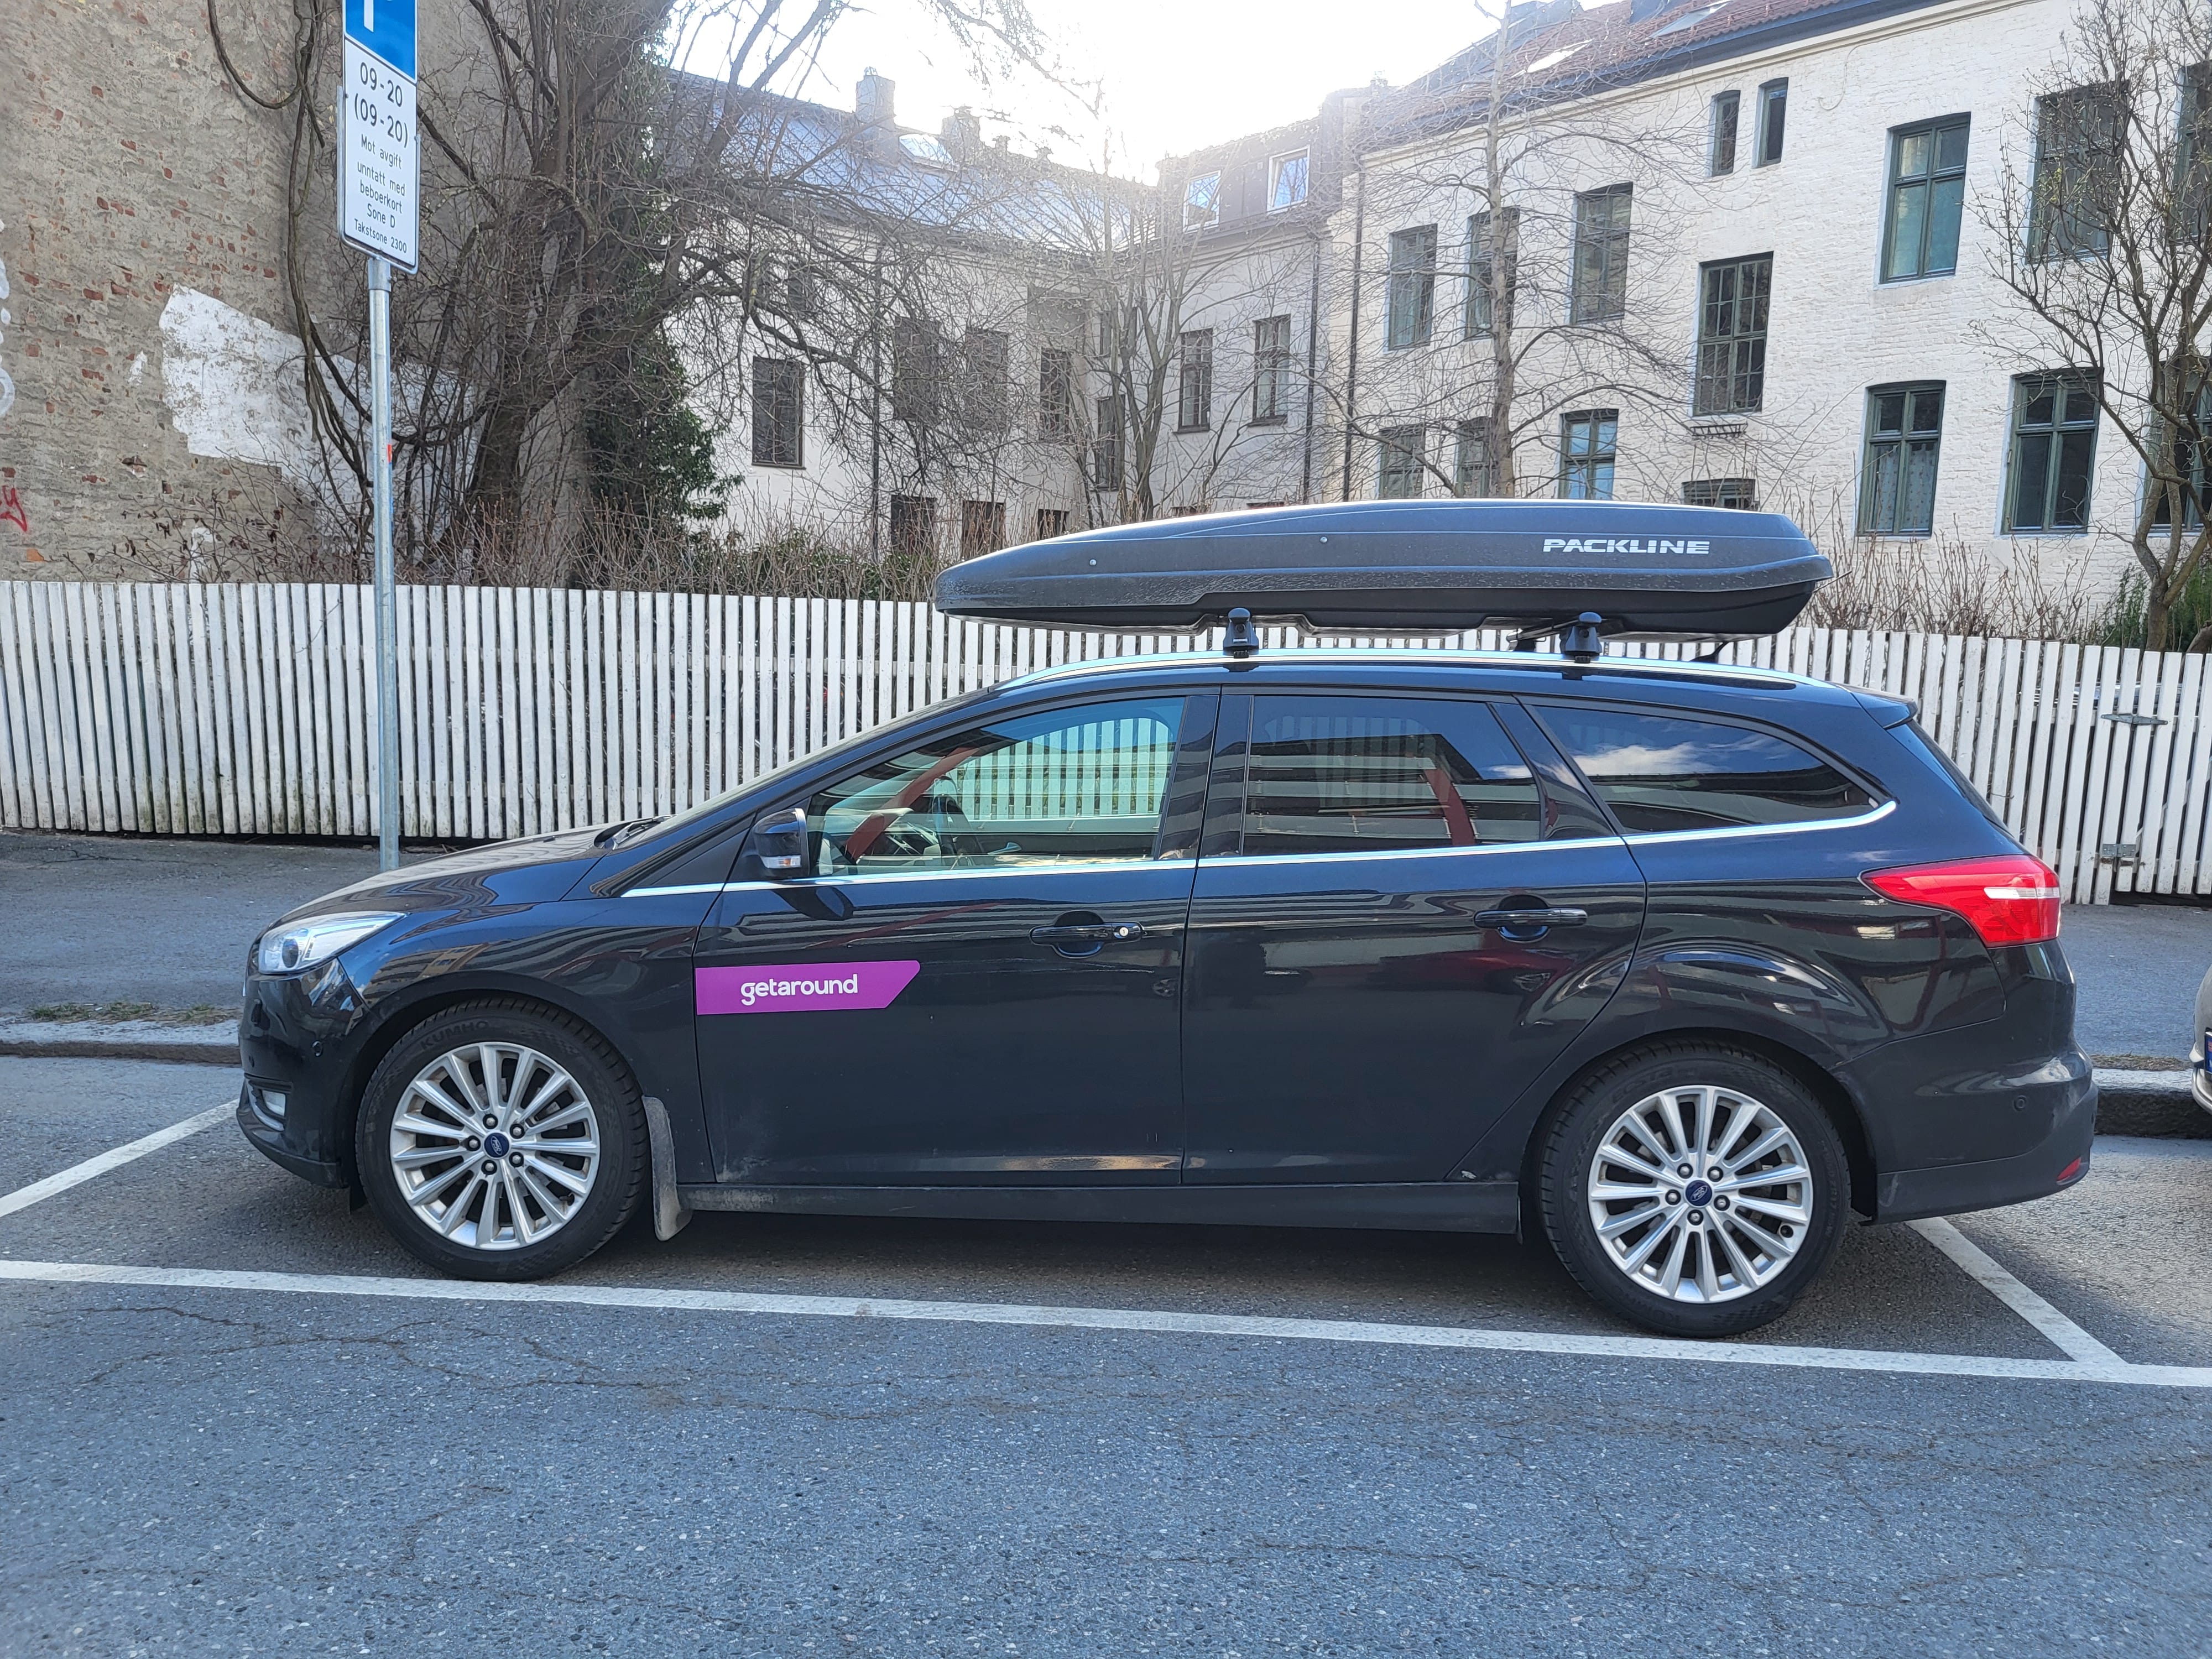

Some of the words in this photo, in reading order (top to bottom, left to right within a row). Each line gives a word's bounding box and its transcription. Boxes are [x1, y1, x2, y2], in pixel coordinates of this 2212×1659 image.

[361, 133, 375, 154] Mot
[380, 148, 401, 169] avgift
[357, 161, 385, 186] unntatt
[389, 179, 405, 196] med
[360, 179, 402, 213] beboerkort
[367, 203, 386, 224] Sone
[390, 215, 395, 228] D
[354, 218, 388, 244] Takstsone
[390, 237, 407, 253] 2300
[1543, 539, 1710, 554] PACKLINE
[740, 974, 858, 1006] getaround
[420, 1020, 489, 1050] KUMHO
